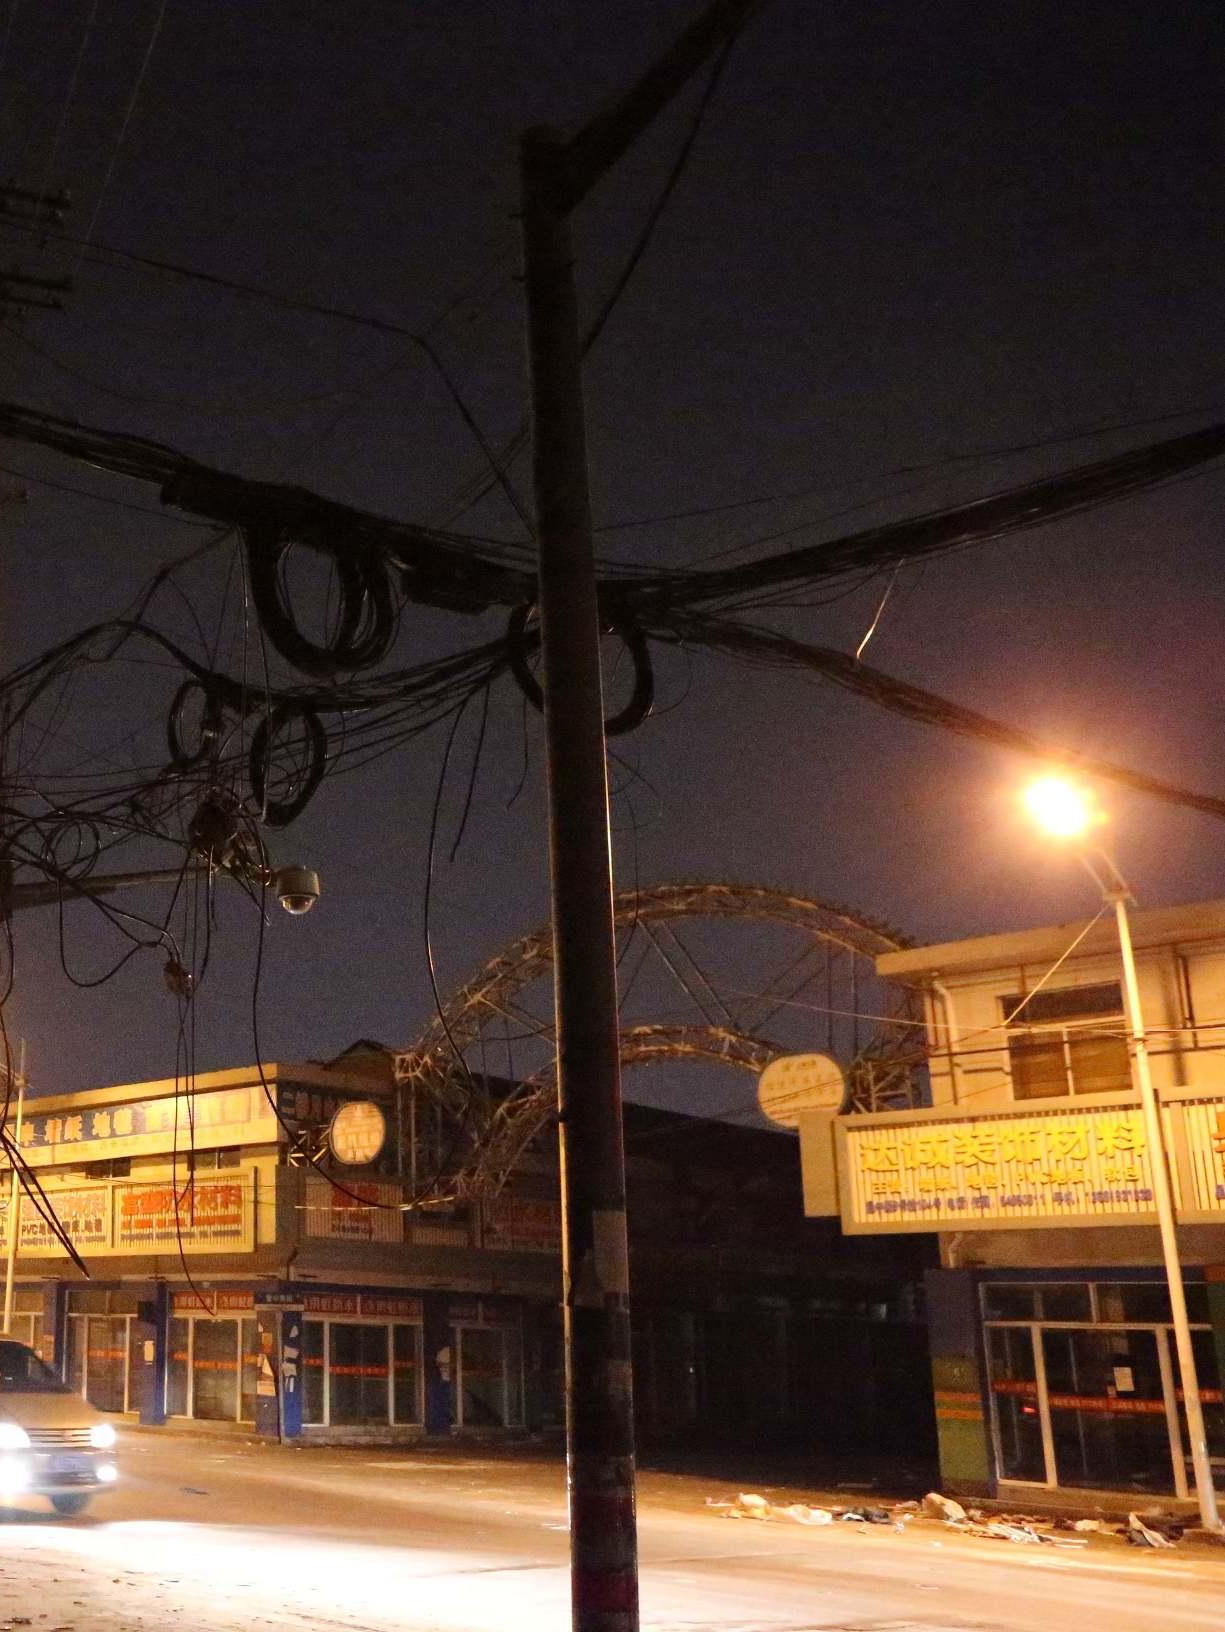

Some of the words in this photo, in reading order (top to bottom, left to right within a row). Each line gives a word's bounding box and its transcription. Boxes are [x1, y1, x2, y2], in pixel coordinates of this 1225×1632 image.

[859, 1120, 1145, 1172] 达诚装饰材料
